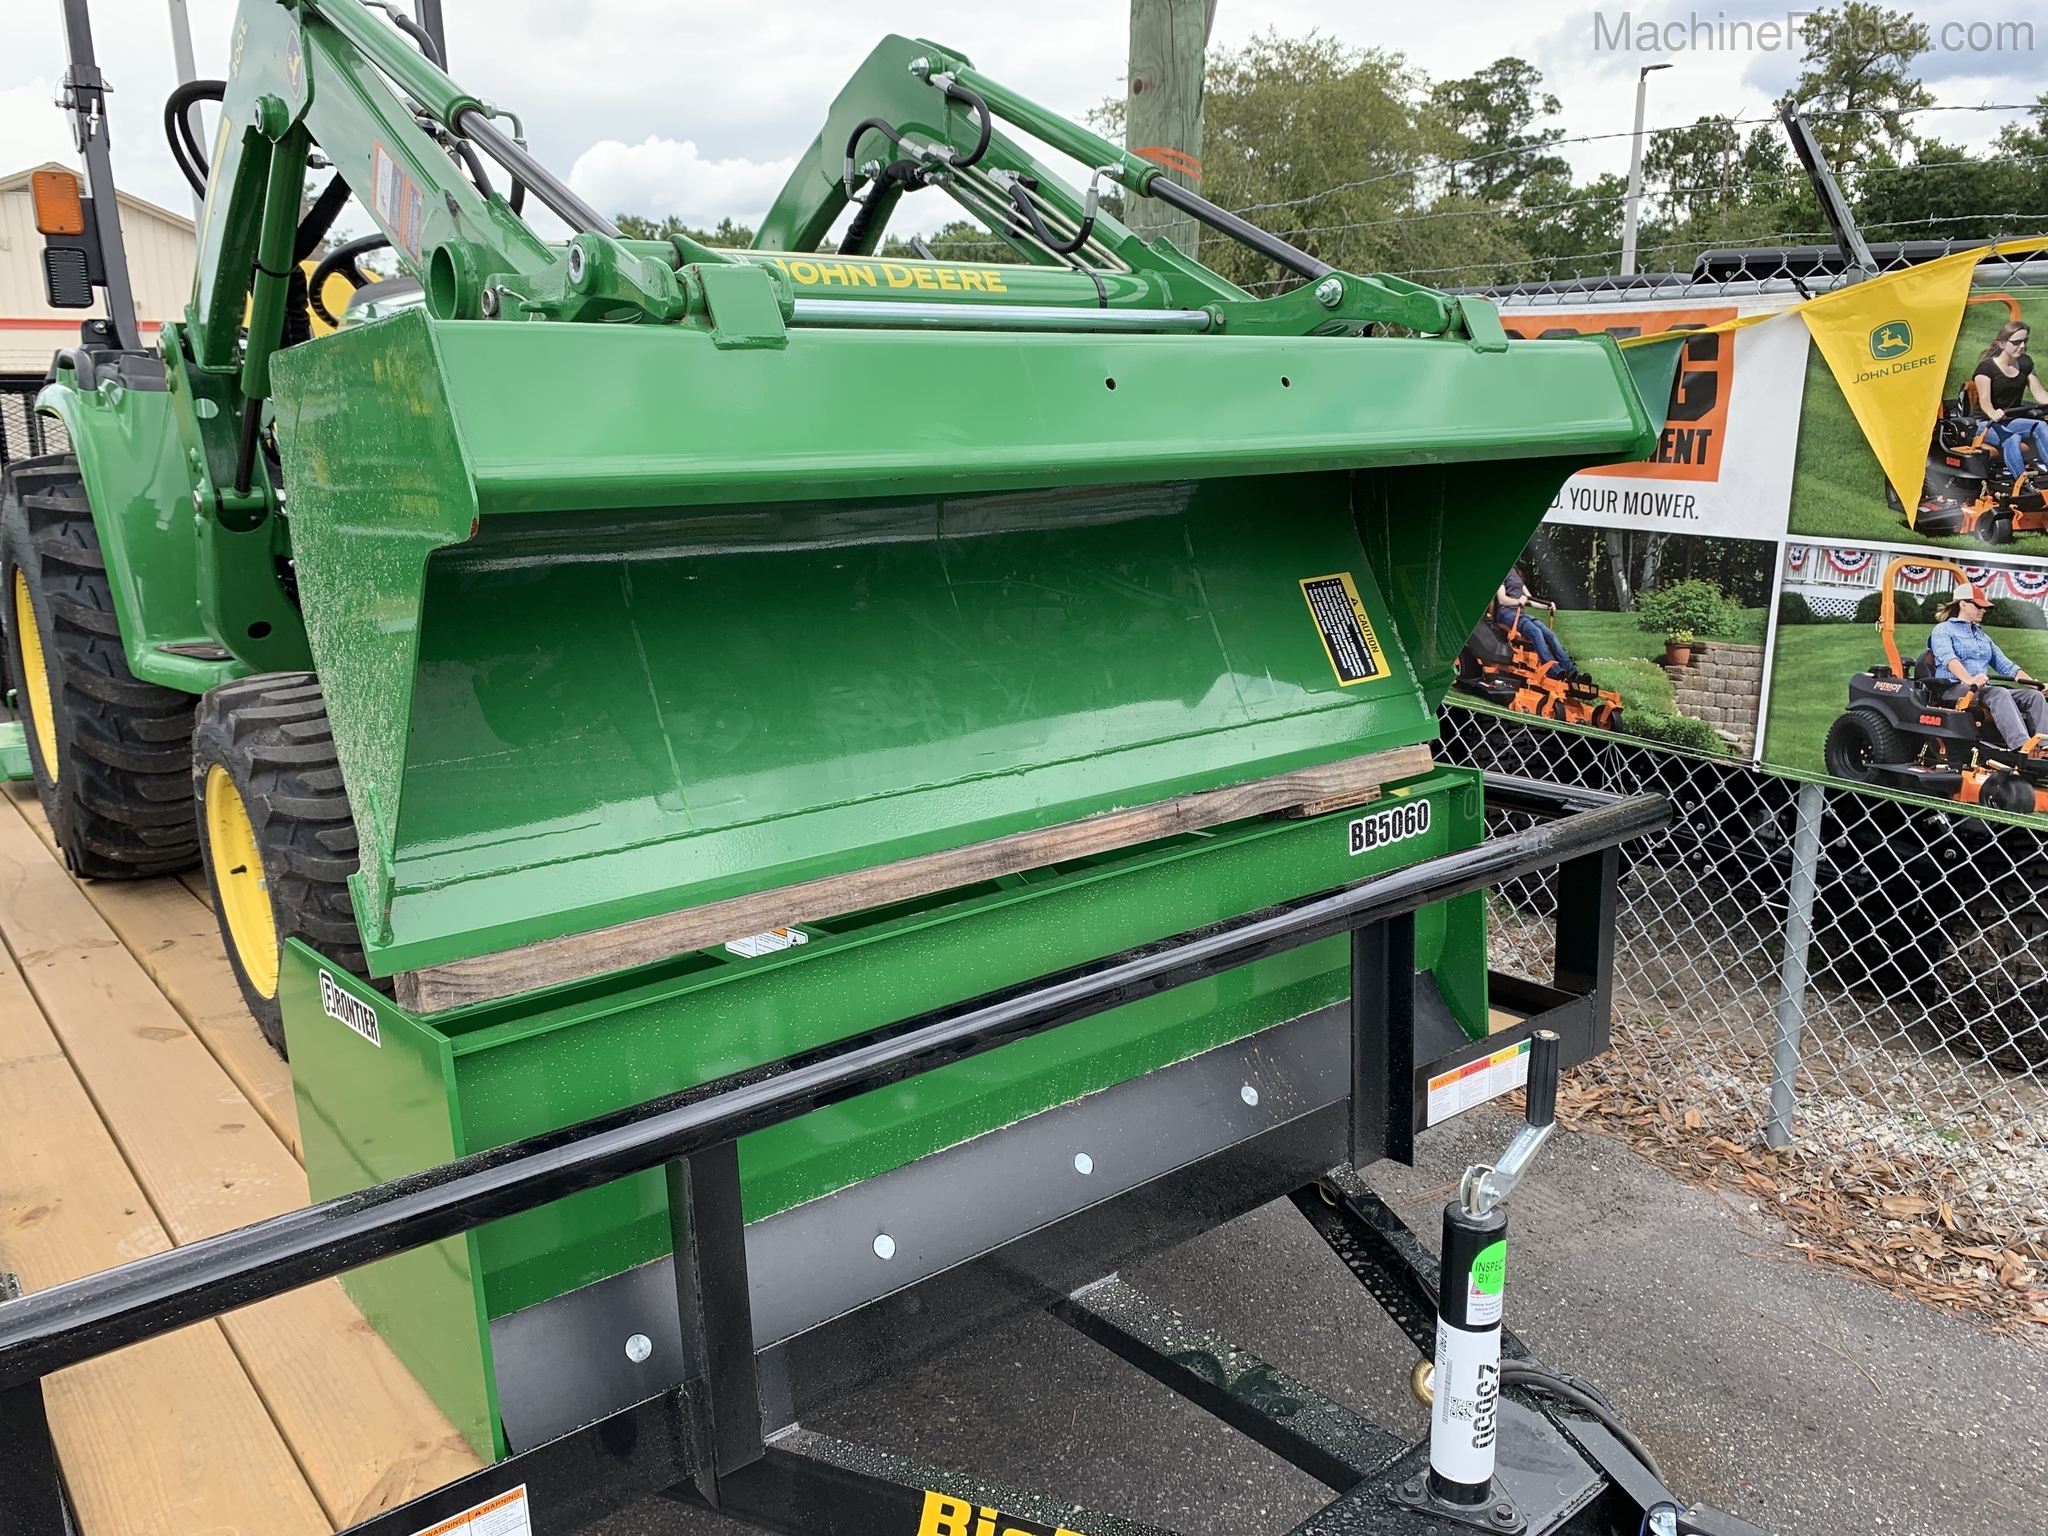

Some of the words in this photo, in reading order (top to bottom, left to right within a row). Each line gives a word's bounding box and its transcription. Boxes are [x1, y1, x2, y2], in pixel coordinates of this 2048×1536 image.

[880, 263, 1008, 293] DEERE
[1852, 367, 1889, 384] JOHN
[1892, 354, 1937, 374] DEERE
[1570, 487, 1618, 513] YOUR
[1623, 491, 1699, 520] MOWER.
[1358, 614, 1379, 653] CAUTION
[1873, 681, 1902, 693] PATRIOT
[1351, 802, 1429, 852] BB5060
[320, 972, 379, 1043] FRONTIER
[483, 1493, 520, 1512] WARNING
